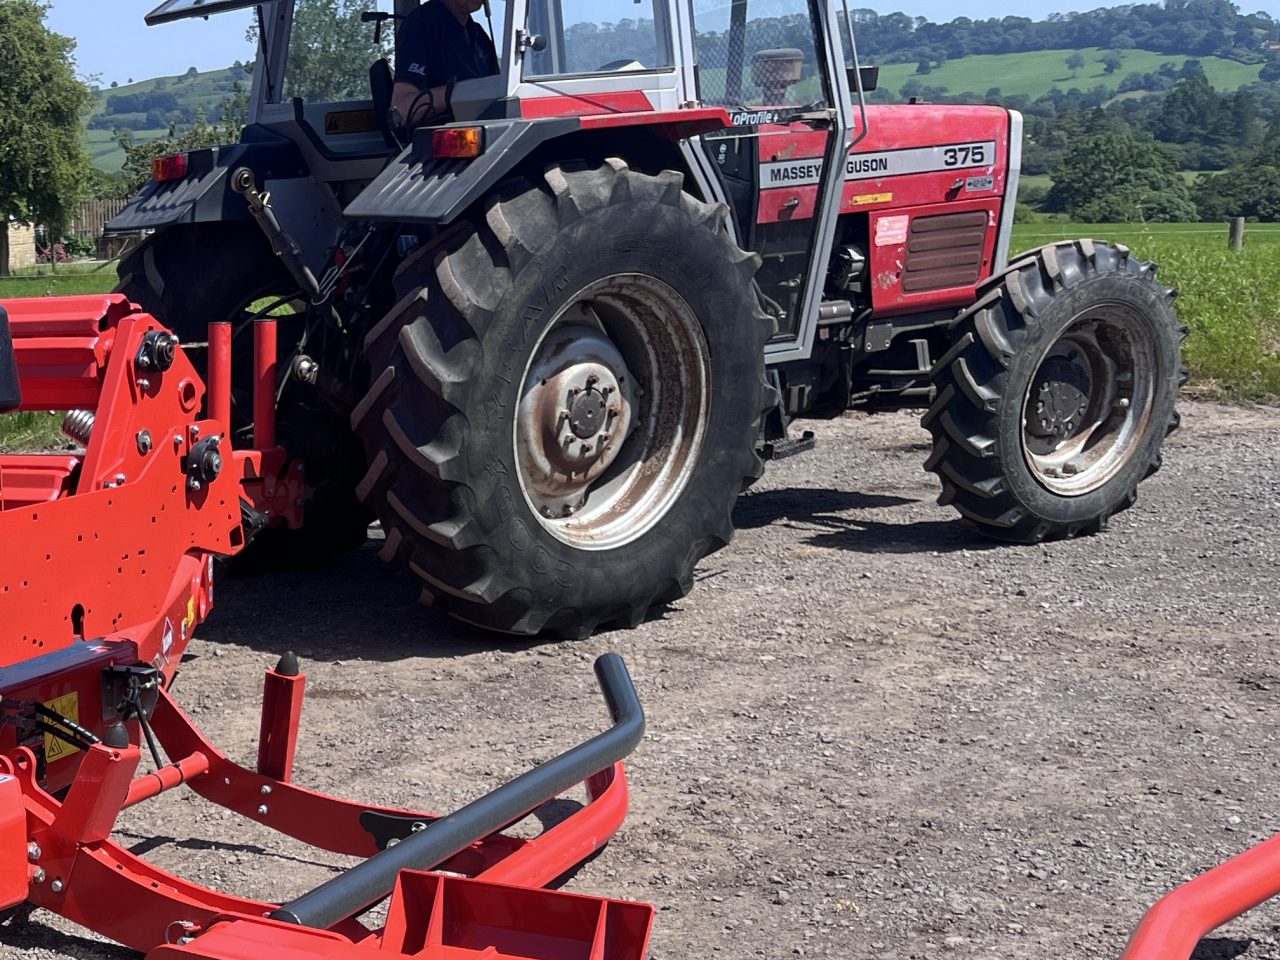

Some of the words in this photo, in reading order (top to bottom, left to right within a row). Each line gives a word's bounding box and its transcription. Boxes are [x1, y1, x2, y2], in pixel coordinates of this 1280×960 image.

[943, 146, 985, 167] 375
[770, 165, 822, 182] MASSEY
[846, 158, 888, 174] GUSON
